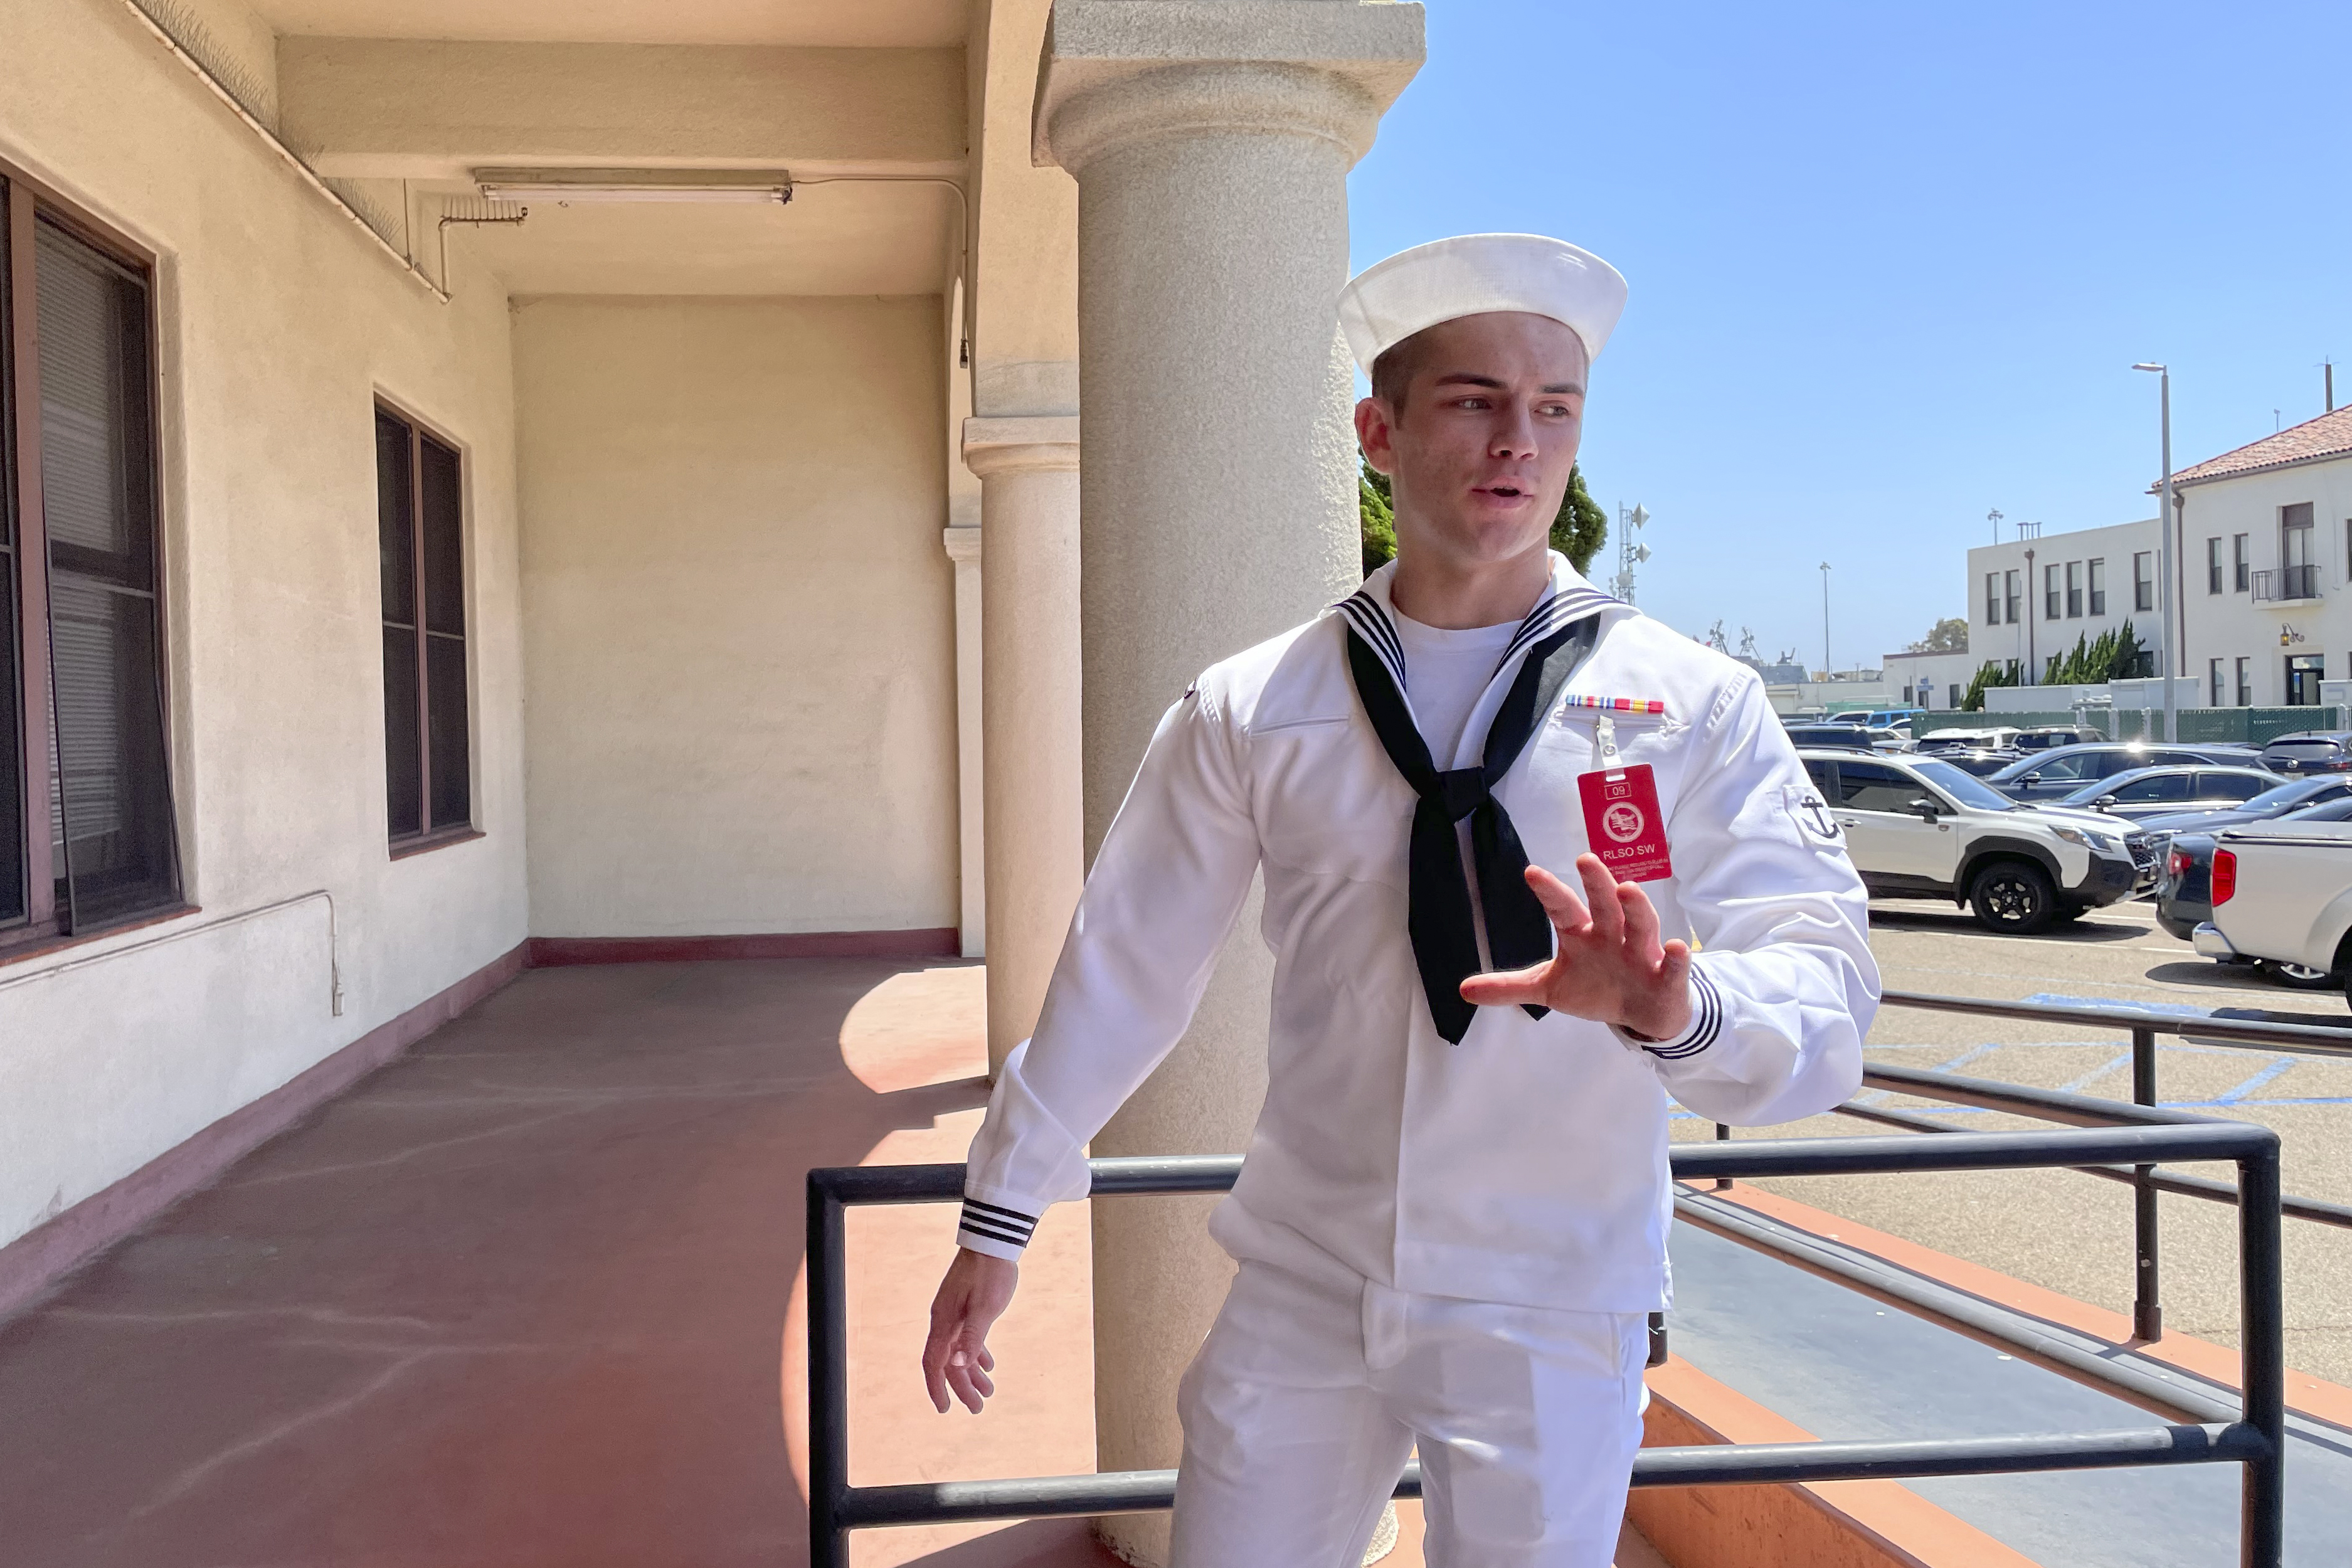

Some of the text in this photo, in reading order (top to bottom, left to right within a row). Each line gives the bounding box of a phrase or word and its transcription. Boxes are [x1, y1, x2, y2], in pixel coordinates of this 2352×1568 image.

[1613, 786, 1625, 796] 09
[1603, 844, 1655, 860] RLSO SW
